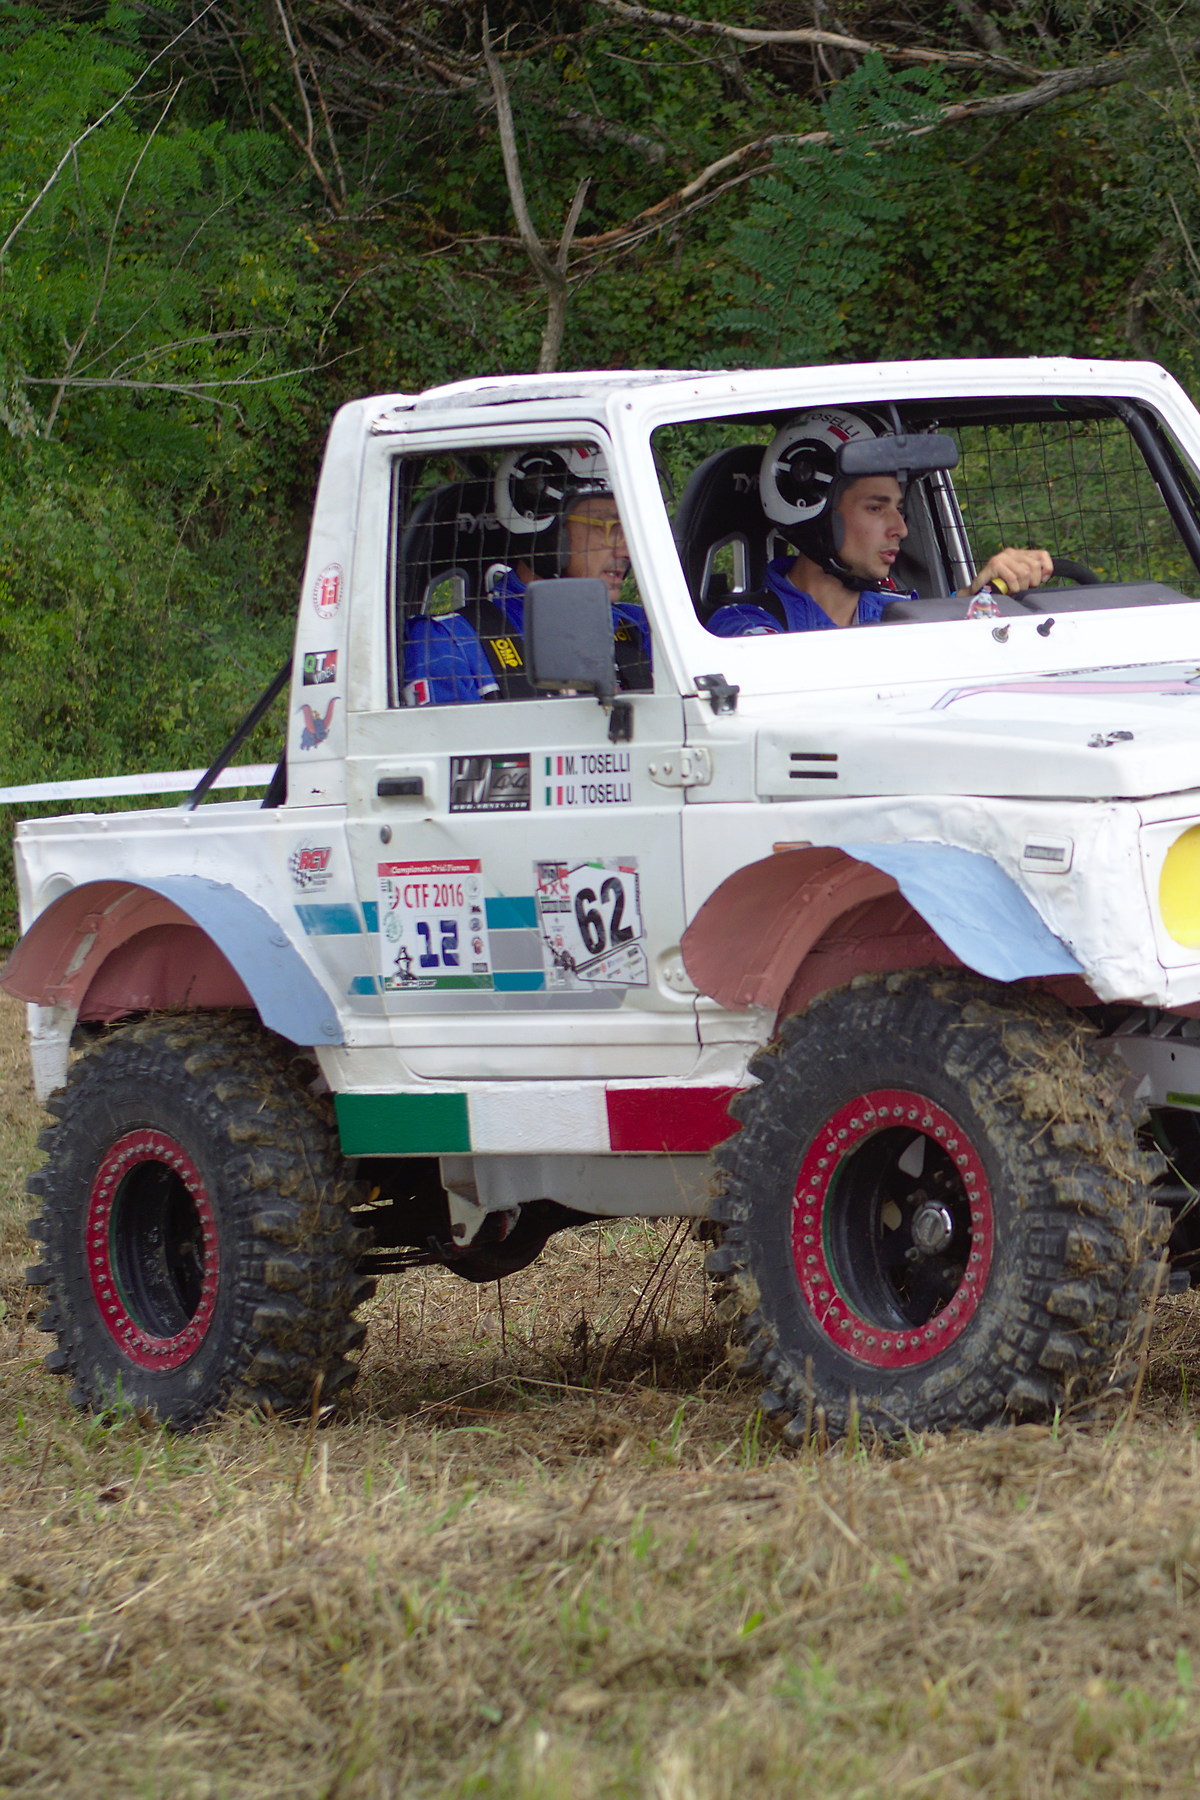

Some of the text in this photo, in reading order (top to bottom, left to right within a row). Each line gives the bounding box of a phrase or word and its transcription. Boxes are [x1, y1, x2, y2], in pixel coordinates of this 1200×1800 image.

[494, 639, 518, 667] OMP
[565, 753, 630, 775] M. TOSELLI
[566, 783, 632, 804] U. TOSELLI
[404, 883, 464, 909] CTF 2016
[575, 876, 634, 955] 62
[417, 920, 459, 967] 12
